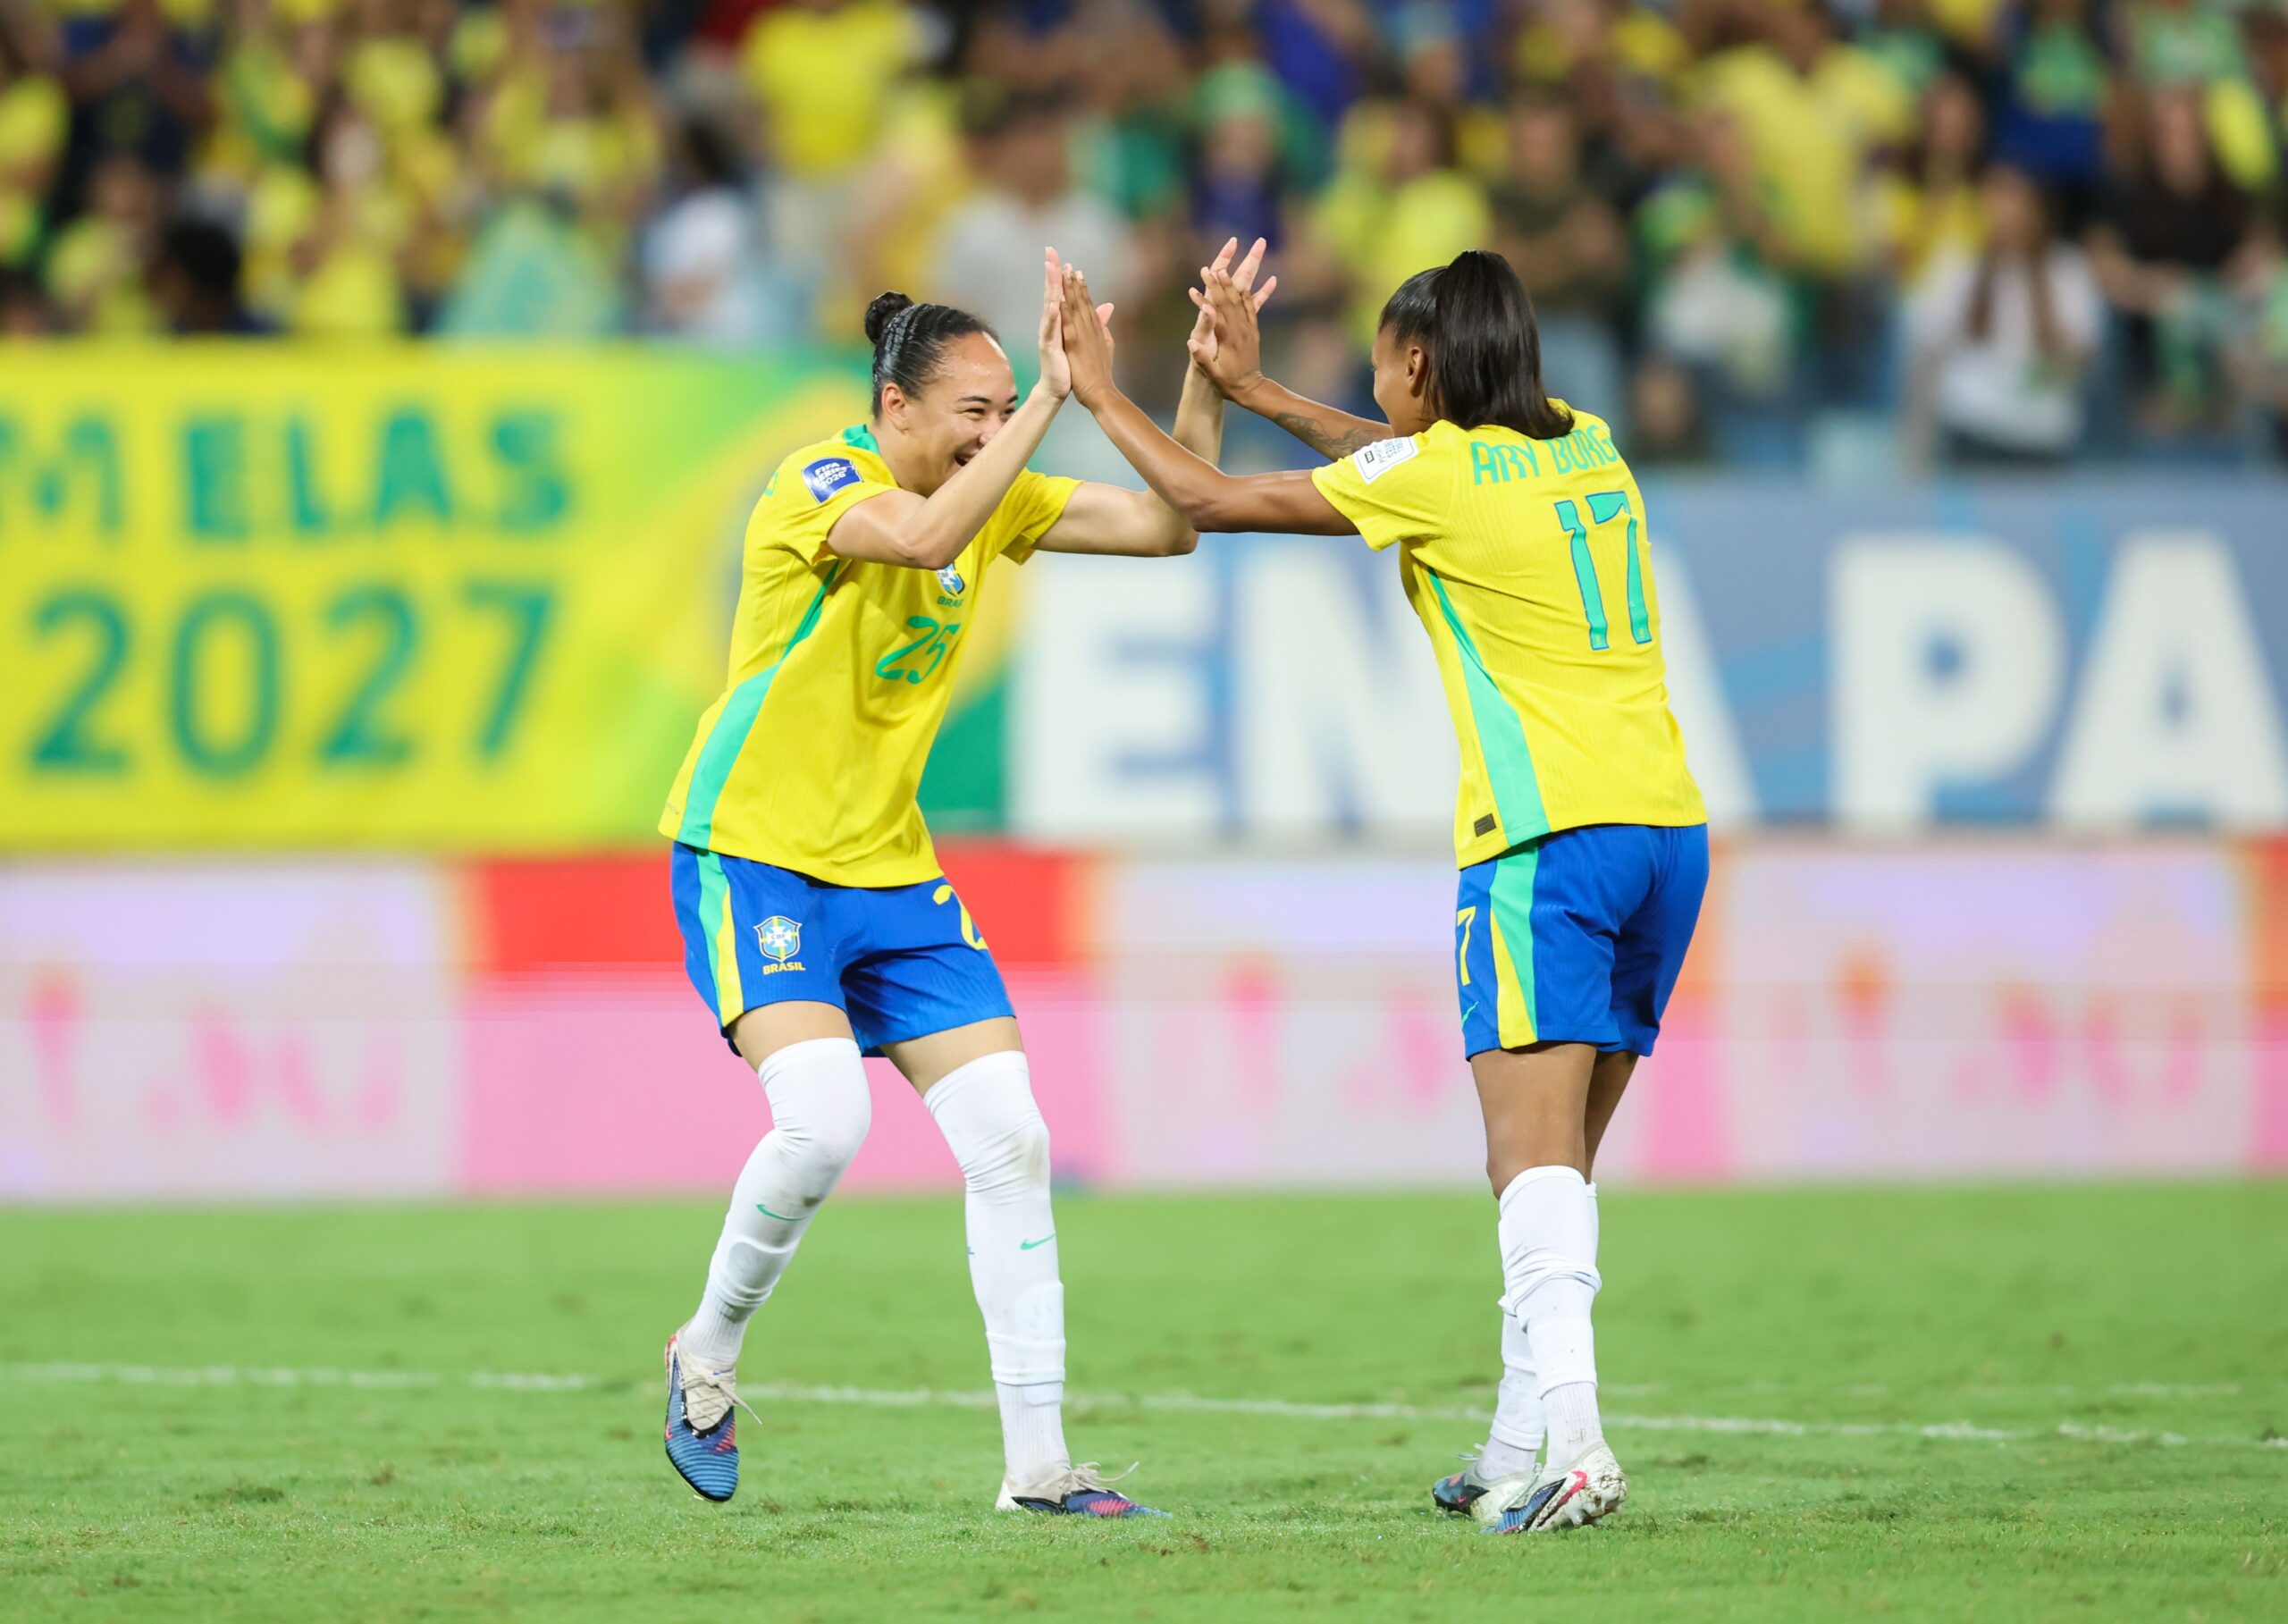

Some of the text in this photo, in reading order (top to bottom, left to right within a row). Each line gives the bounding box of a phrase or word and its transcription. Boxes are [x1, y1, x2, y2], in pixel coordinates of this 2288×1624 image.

[181, 406, 572, 542] ELAS
[814, 462, 841, 476] FIFA
[1470, 439, 1541, 485] ARY
[937, 594, 964, 609] BRA
[1553, 491, 1653, 651] 17
[29, 579, 556, 774] 2027
[874, 615, 962, 685] 25
[1826, 533, 2288, 829] PA
[762, 961, 806, 976] BRASIL
